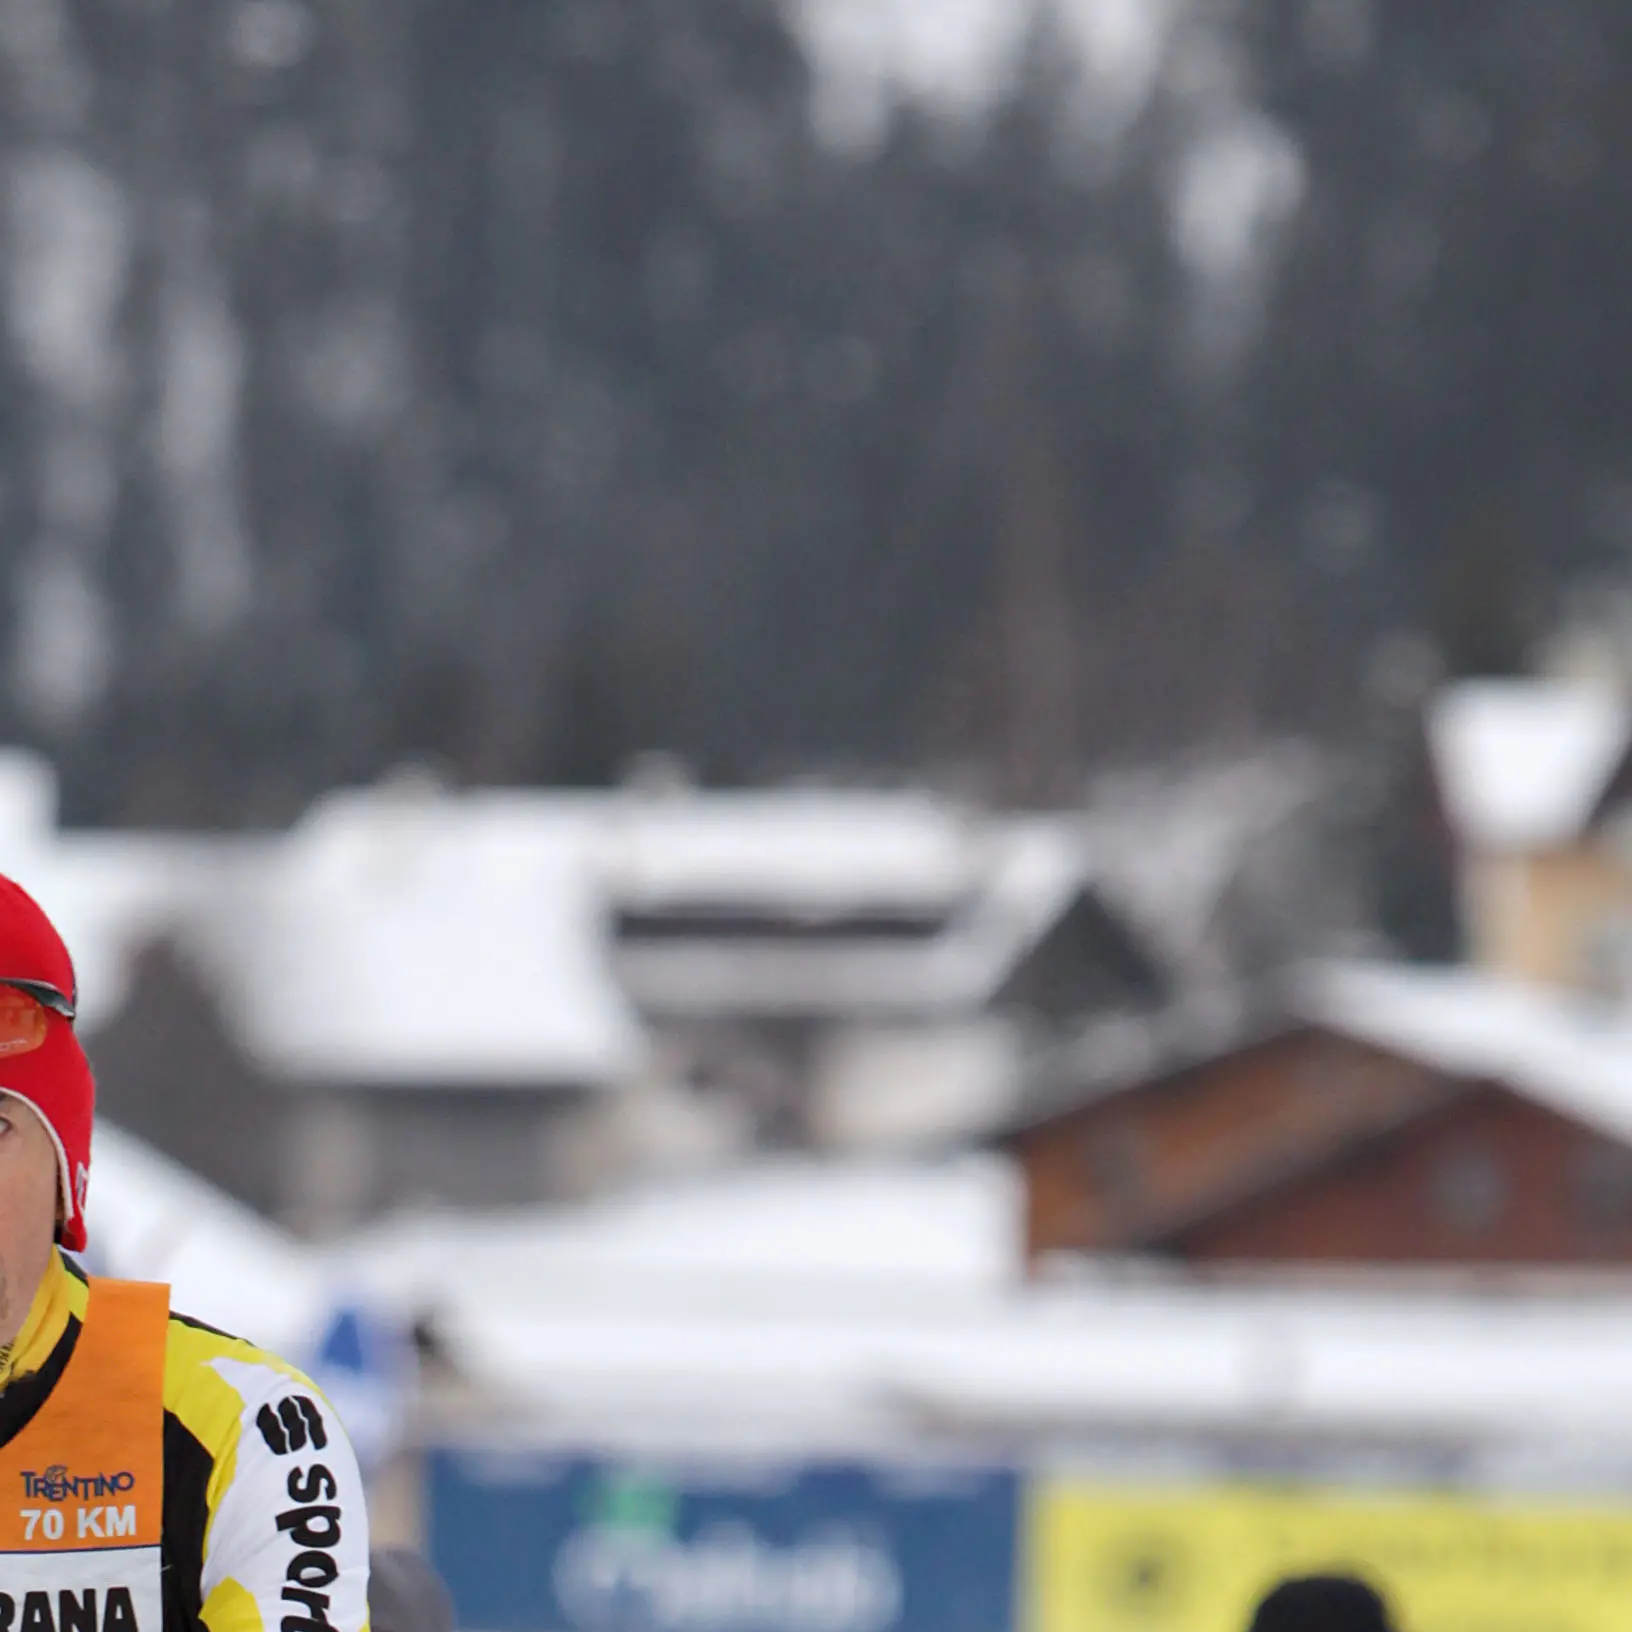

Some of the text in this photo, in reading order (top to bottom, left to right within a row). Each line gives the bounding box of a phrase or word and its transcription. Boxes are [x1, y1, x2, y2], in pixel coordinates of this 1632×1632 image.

[20, 1470, 136, 1502] TRENTINO
[20, 1504, 137, 1541] 70 KM
